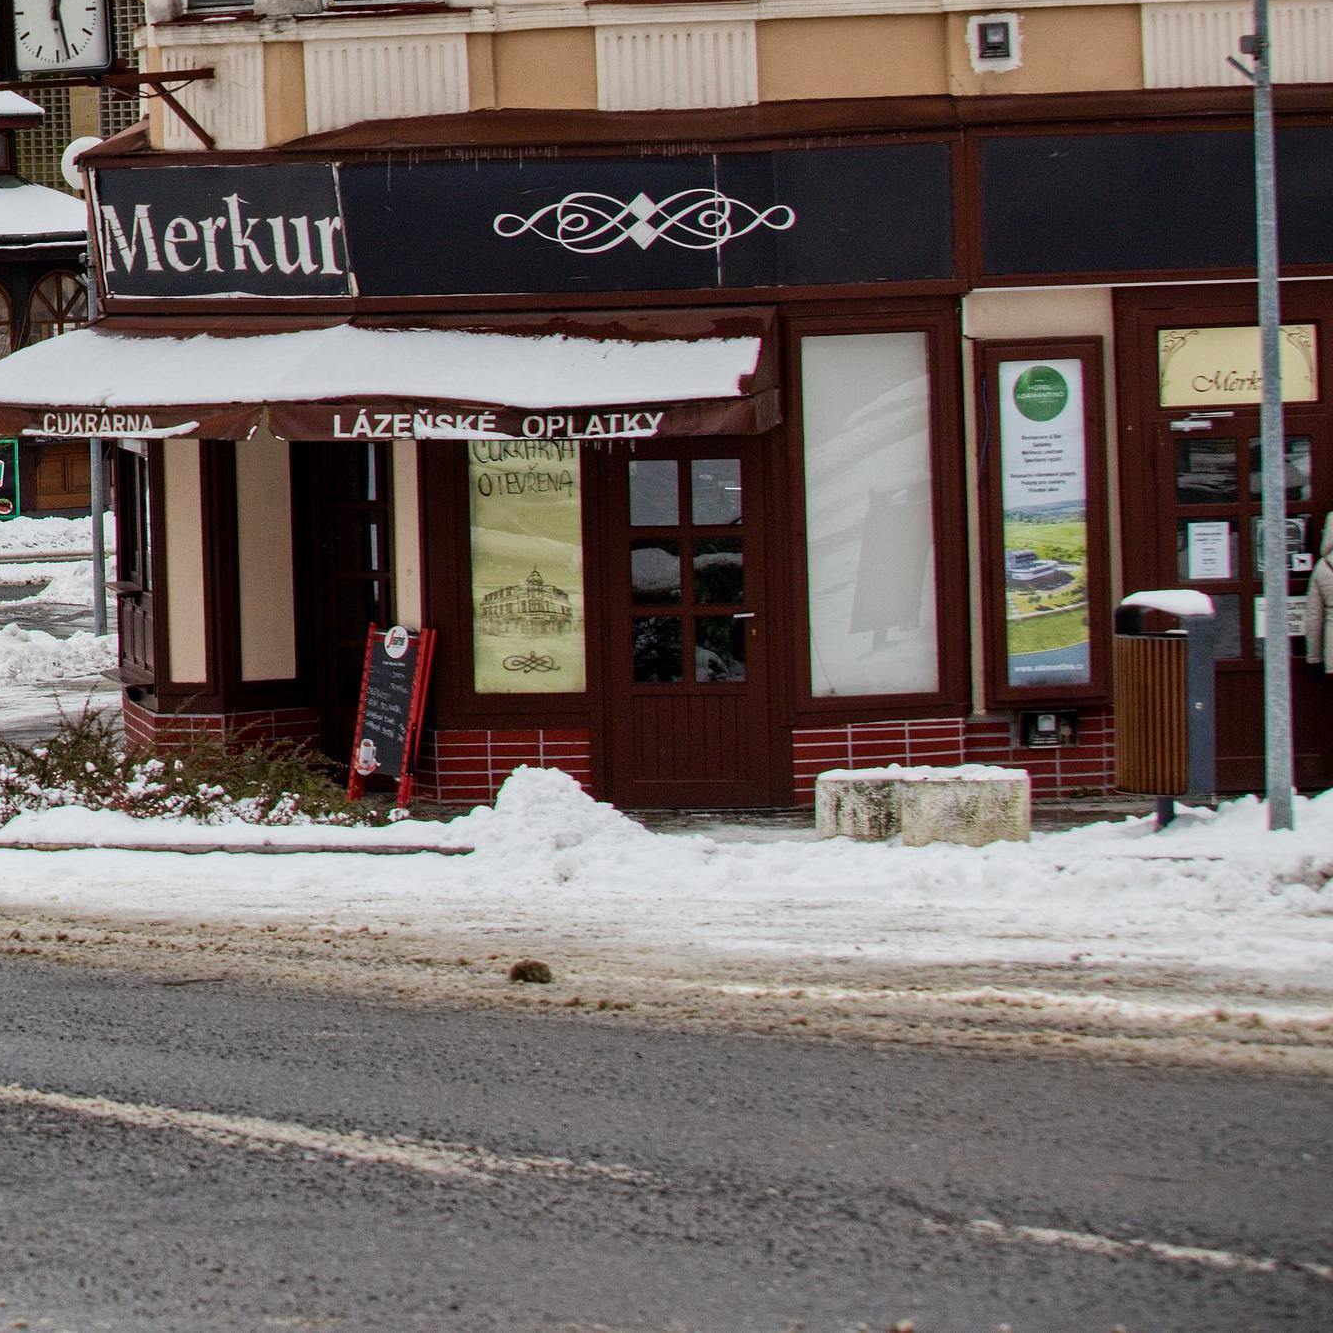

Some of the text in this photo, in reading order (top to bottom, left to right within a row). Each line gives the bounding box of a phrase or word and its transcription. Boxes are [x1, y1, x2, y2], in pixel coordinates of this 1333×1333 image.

[100, 192, 344, 275] Merkur
[1191, 370, 1282, 393] Merk
[43, 408, 153, 436] CUKRÁRNA
[333, 408, 665, 438] LÁZEŇSKÉ OPLATKY
[478, 465, 573, 497] OTEVŘENA
